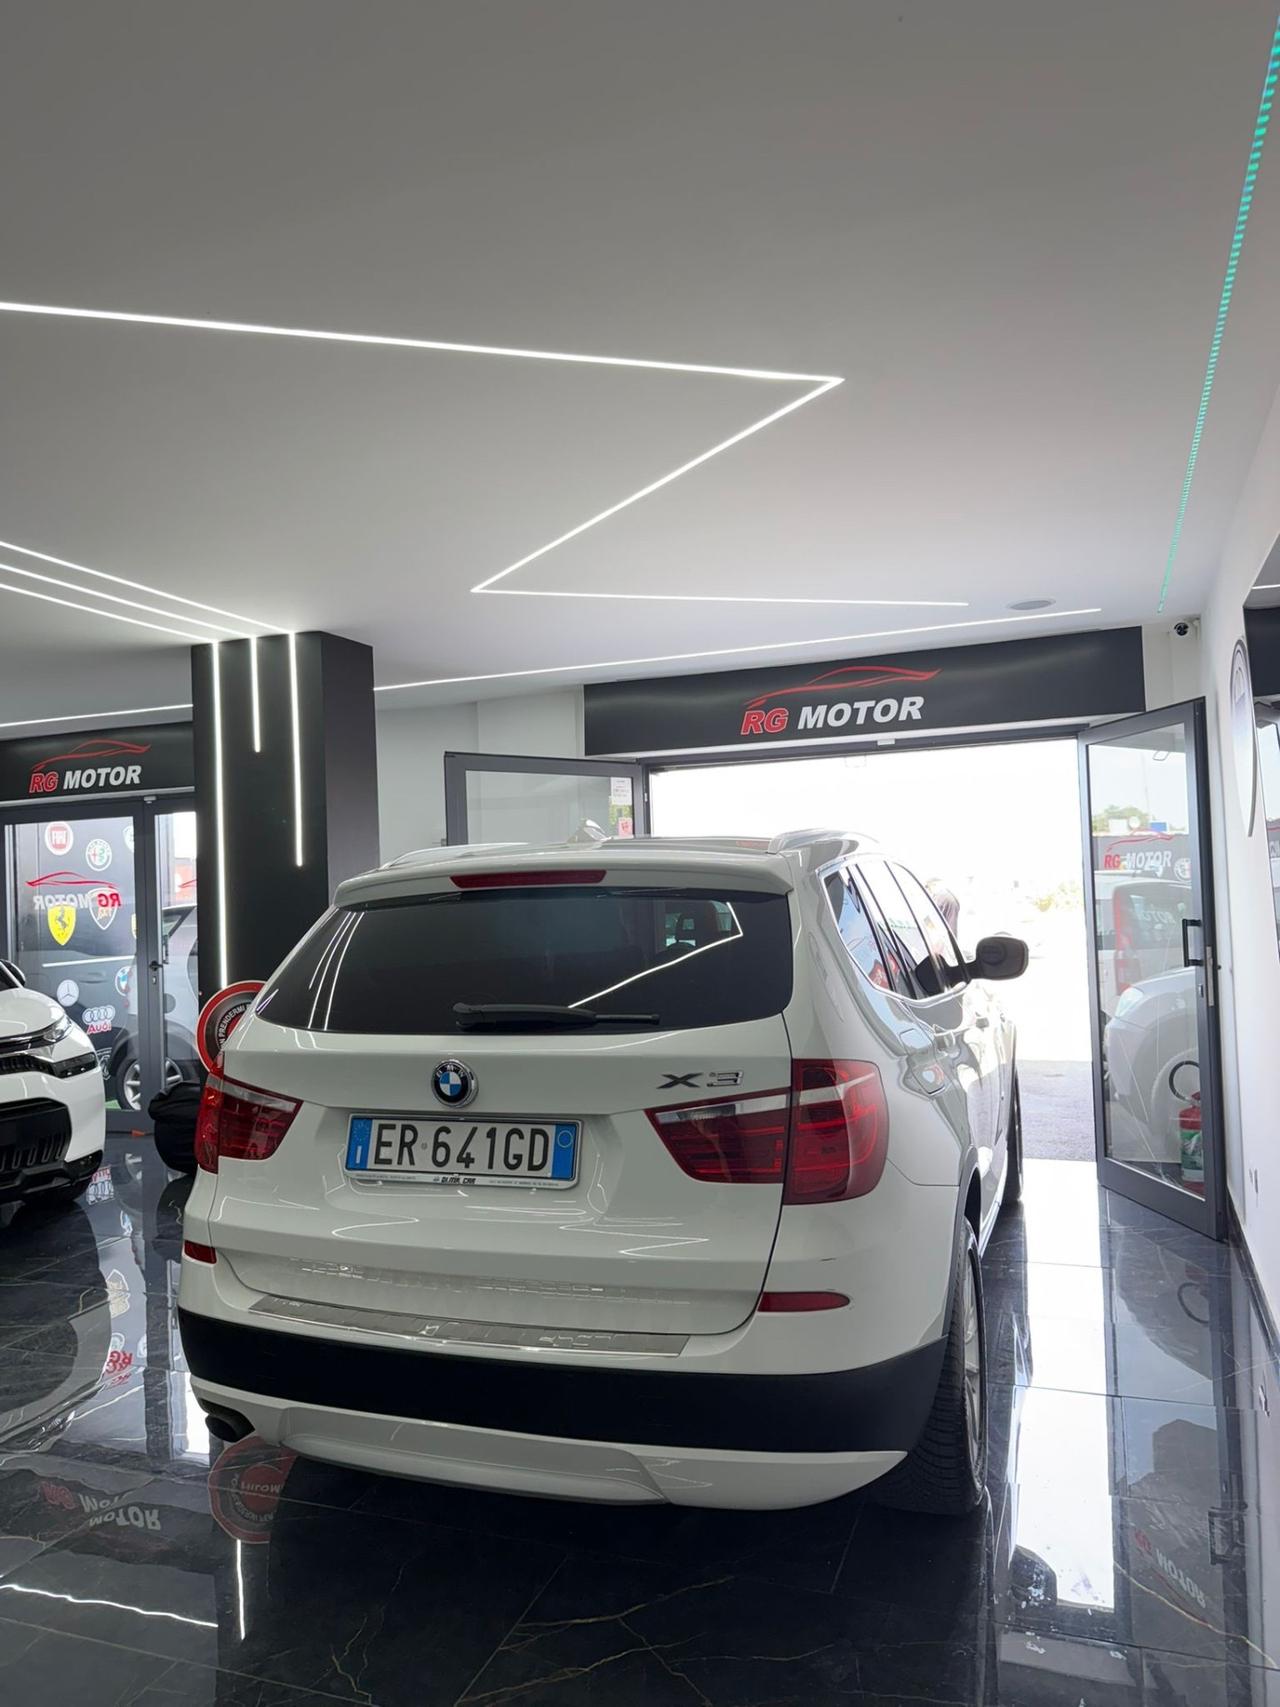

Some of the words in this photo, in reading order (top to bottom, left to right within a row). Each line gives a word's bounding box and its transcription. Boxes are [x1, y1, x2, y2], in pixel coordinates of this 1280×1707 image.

[740, 707, 789, 735] RG
[797, 696, 925, 730] MOTOR
[29, 771, 60, 793] RG
[63, 765, 142, 789] MOTOR
[1124, 850, 1172, 869] MOTOR
[656, 1071, 744, 1089] X3
